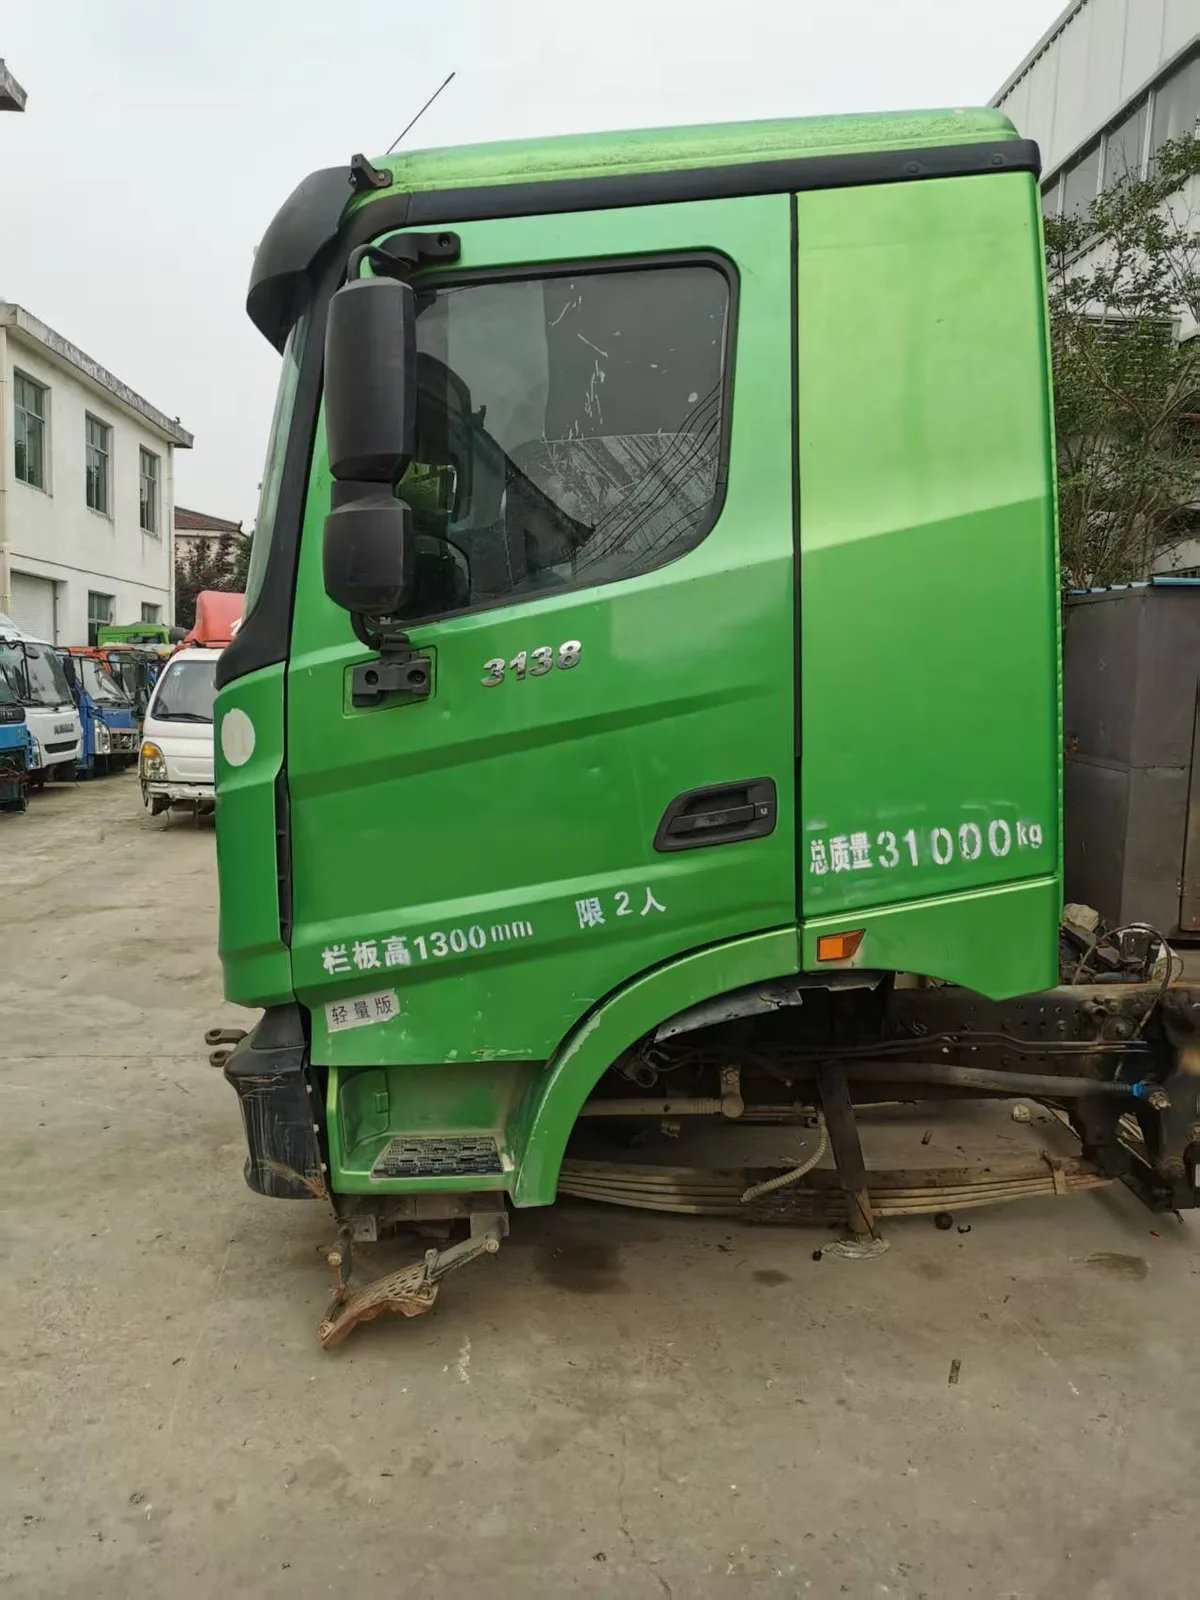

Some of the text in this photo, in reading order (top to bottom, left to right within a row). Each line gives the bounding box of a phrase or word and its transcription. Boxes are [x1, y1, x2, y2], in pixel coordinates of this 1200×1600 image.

[480, 640, 582, 688] 3138
[331, 995, 394, 1025] 轻量版
